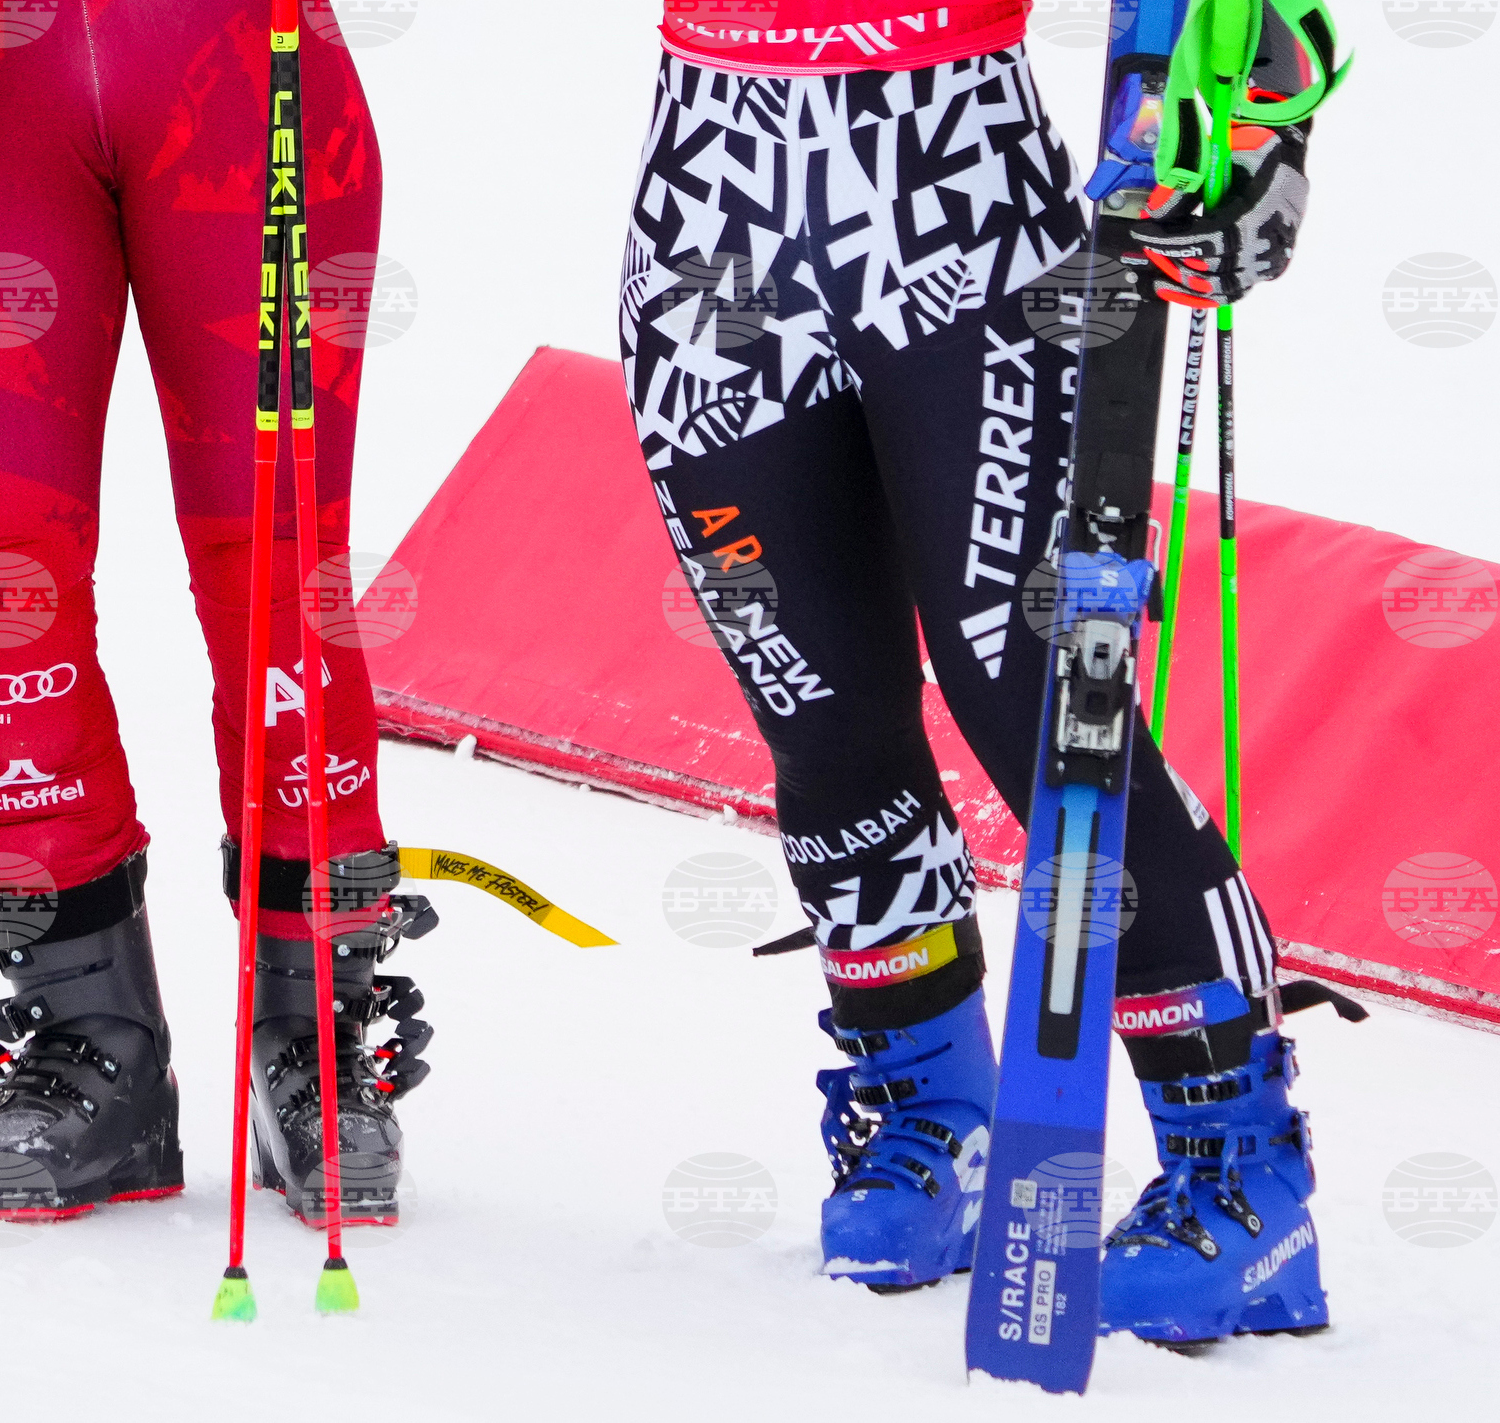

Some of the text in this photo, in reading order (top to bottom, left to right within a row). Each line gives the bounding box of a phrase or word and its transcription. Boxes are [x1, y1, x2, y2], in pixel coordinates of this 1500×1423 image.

[270, 90, 298, 216] LEKI
[291, 224, 312, 349] LEKI
[964, 324, 1035, 589] TERREX
[653, 480, 797, 717] ZEALAND
[734, 601, 835, 702] NEW
[781, 789, 922, 865] COOLABAH
[434, 854, 550, 916] MAKES ME FASTER!
[821, 947, 929, 980] SALOMON
[999, 1221, 1031, 1342] S/RACE
[1035, 1269, 1053, 1307] PRO
[1242, 1222, 1317, 1294] SALOMON
[1034, 1313, 1048, 1337] GS
[1055, 1293, 1068, 1317] 182
